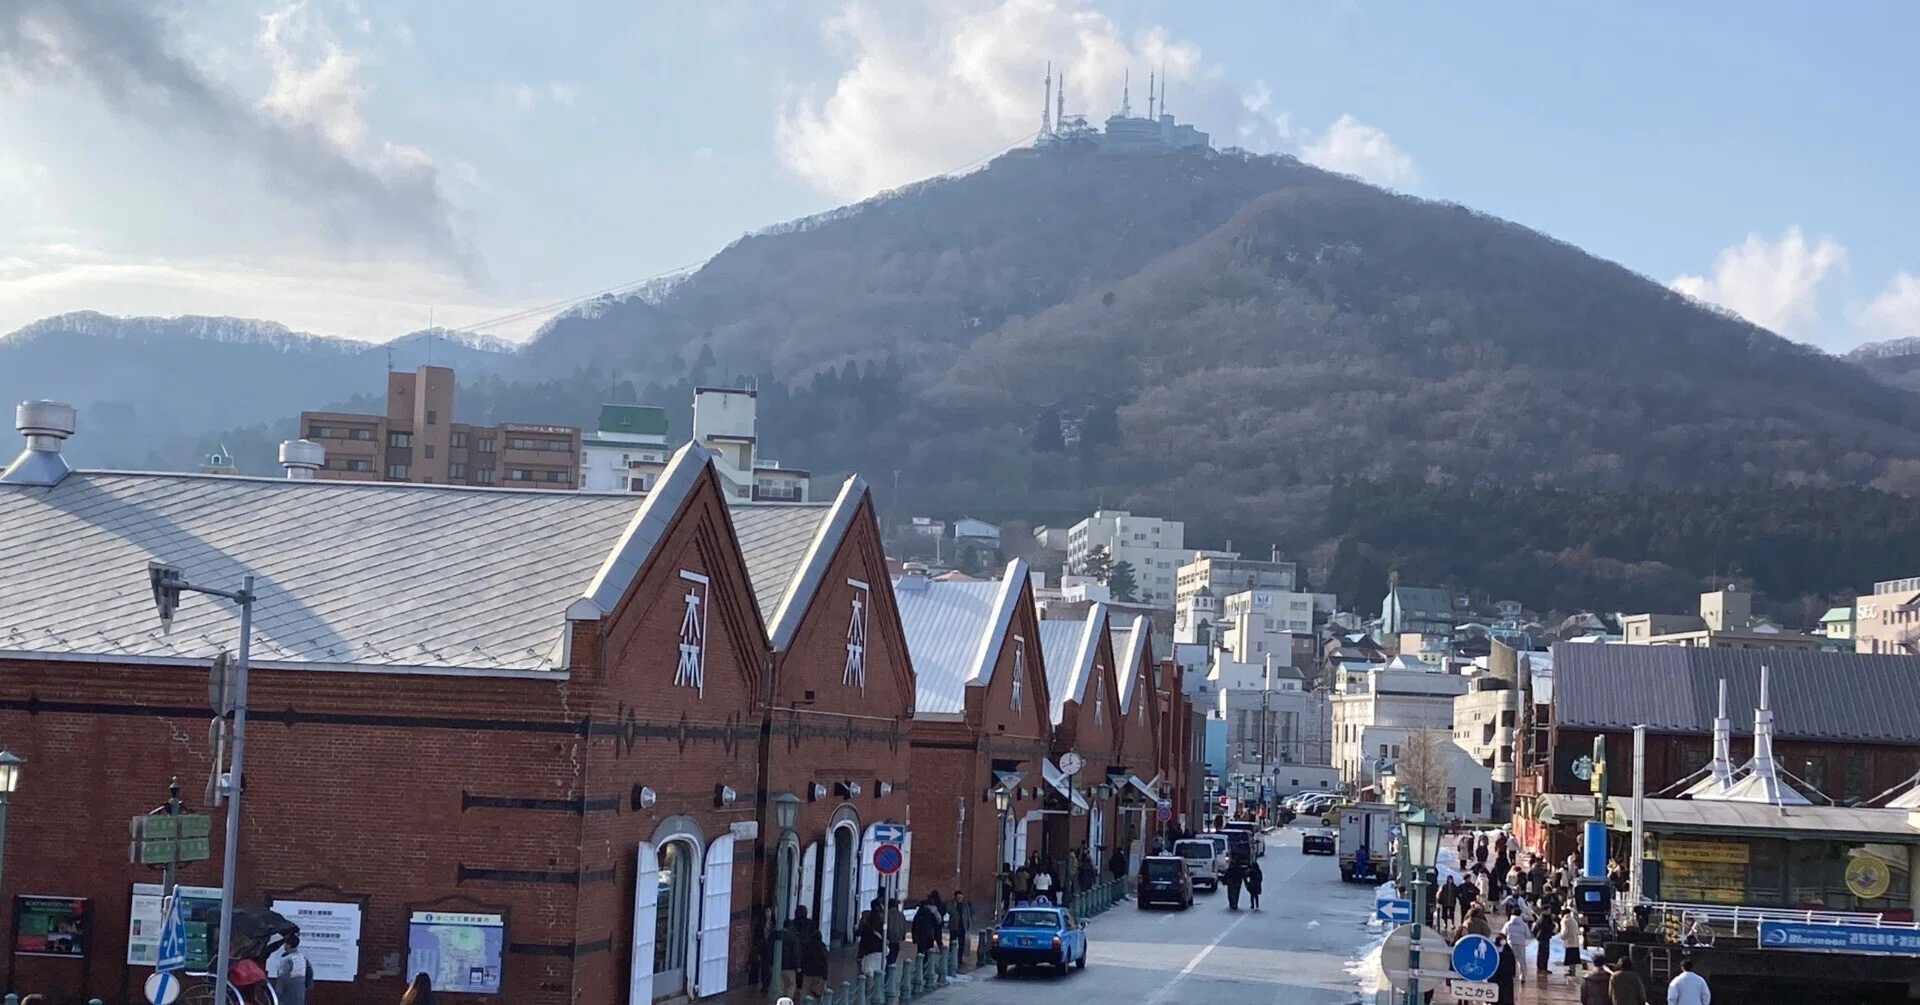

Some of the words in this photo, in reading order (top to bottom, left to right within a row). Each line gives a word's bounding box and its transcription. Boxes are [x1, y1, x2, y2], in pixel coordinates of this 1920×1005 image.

[1857, 604, 1879, 620] SEC
[1454, 987, 1495, 998] ここから
